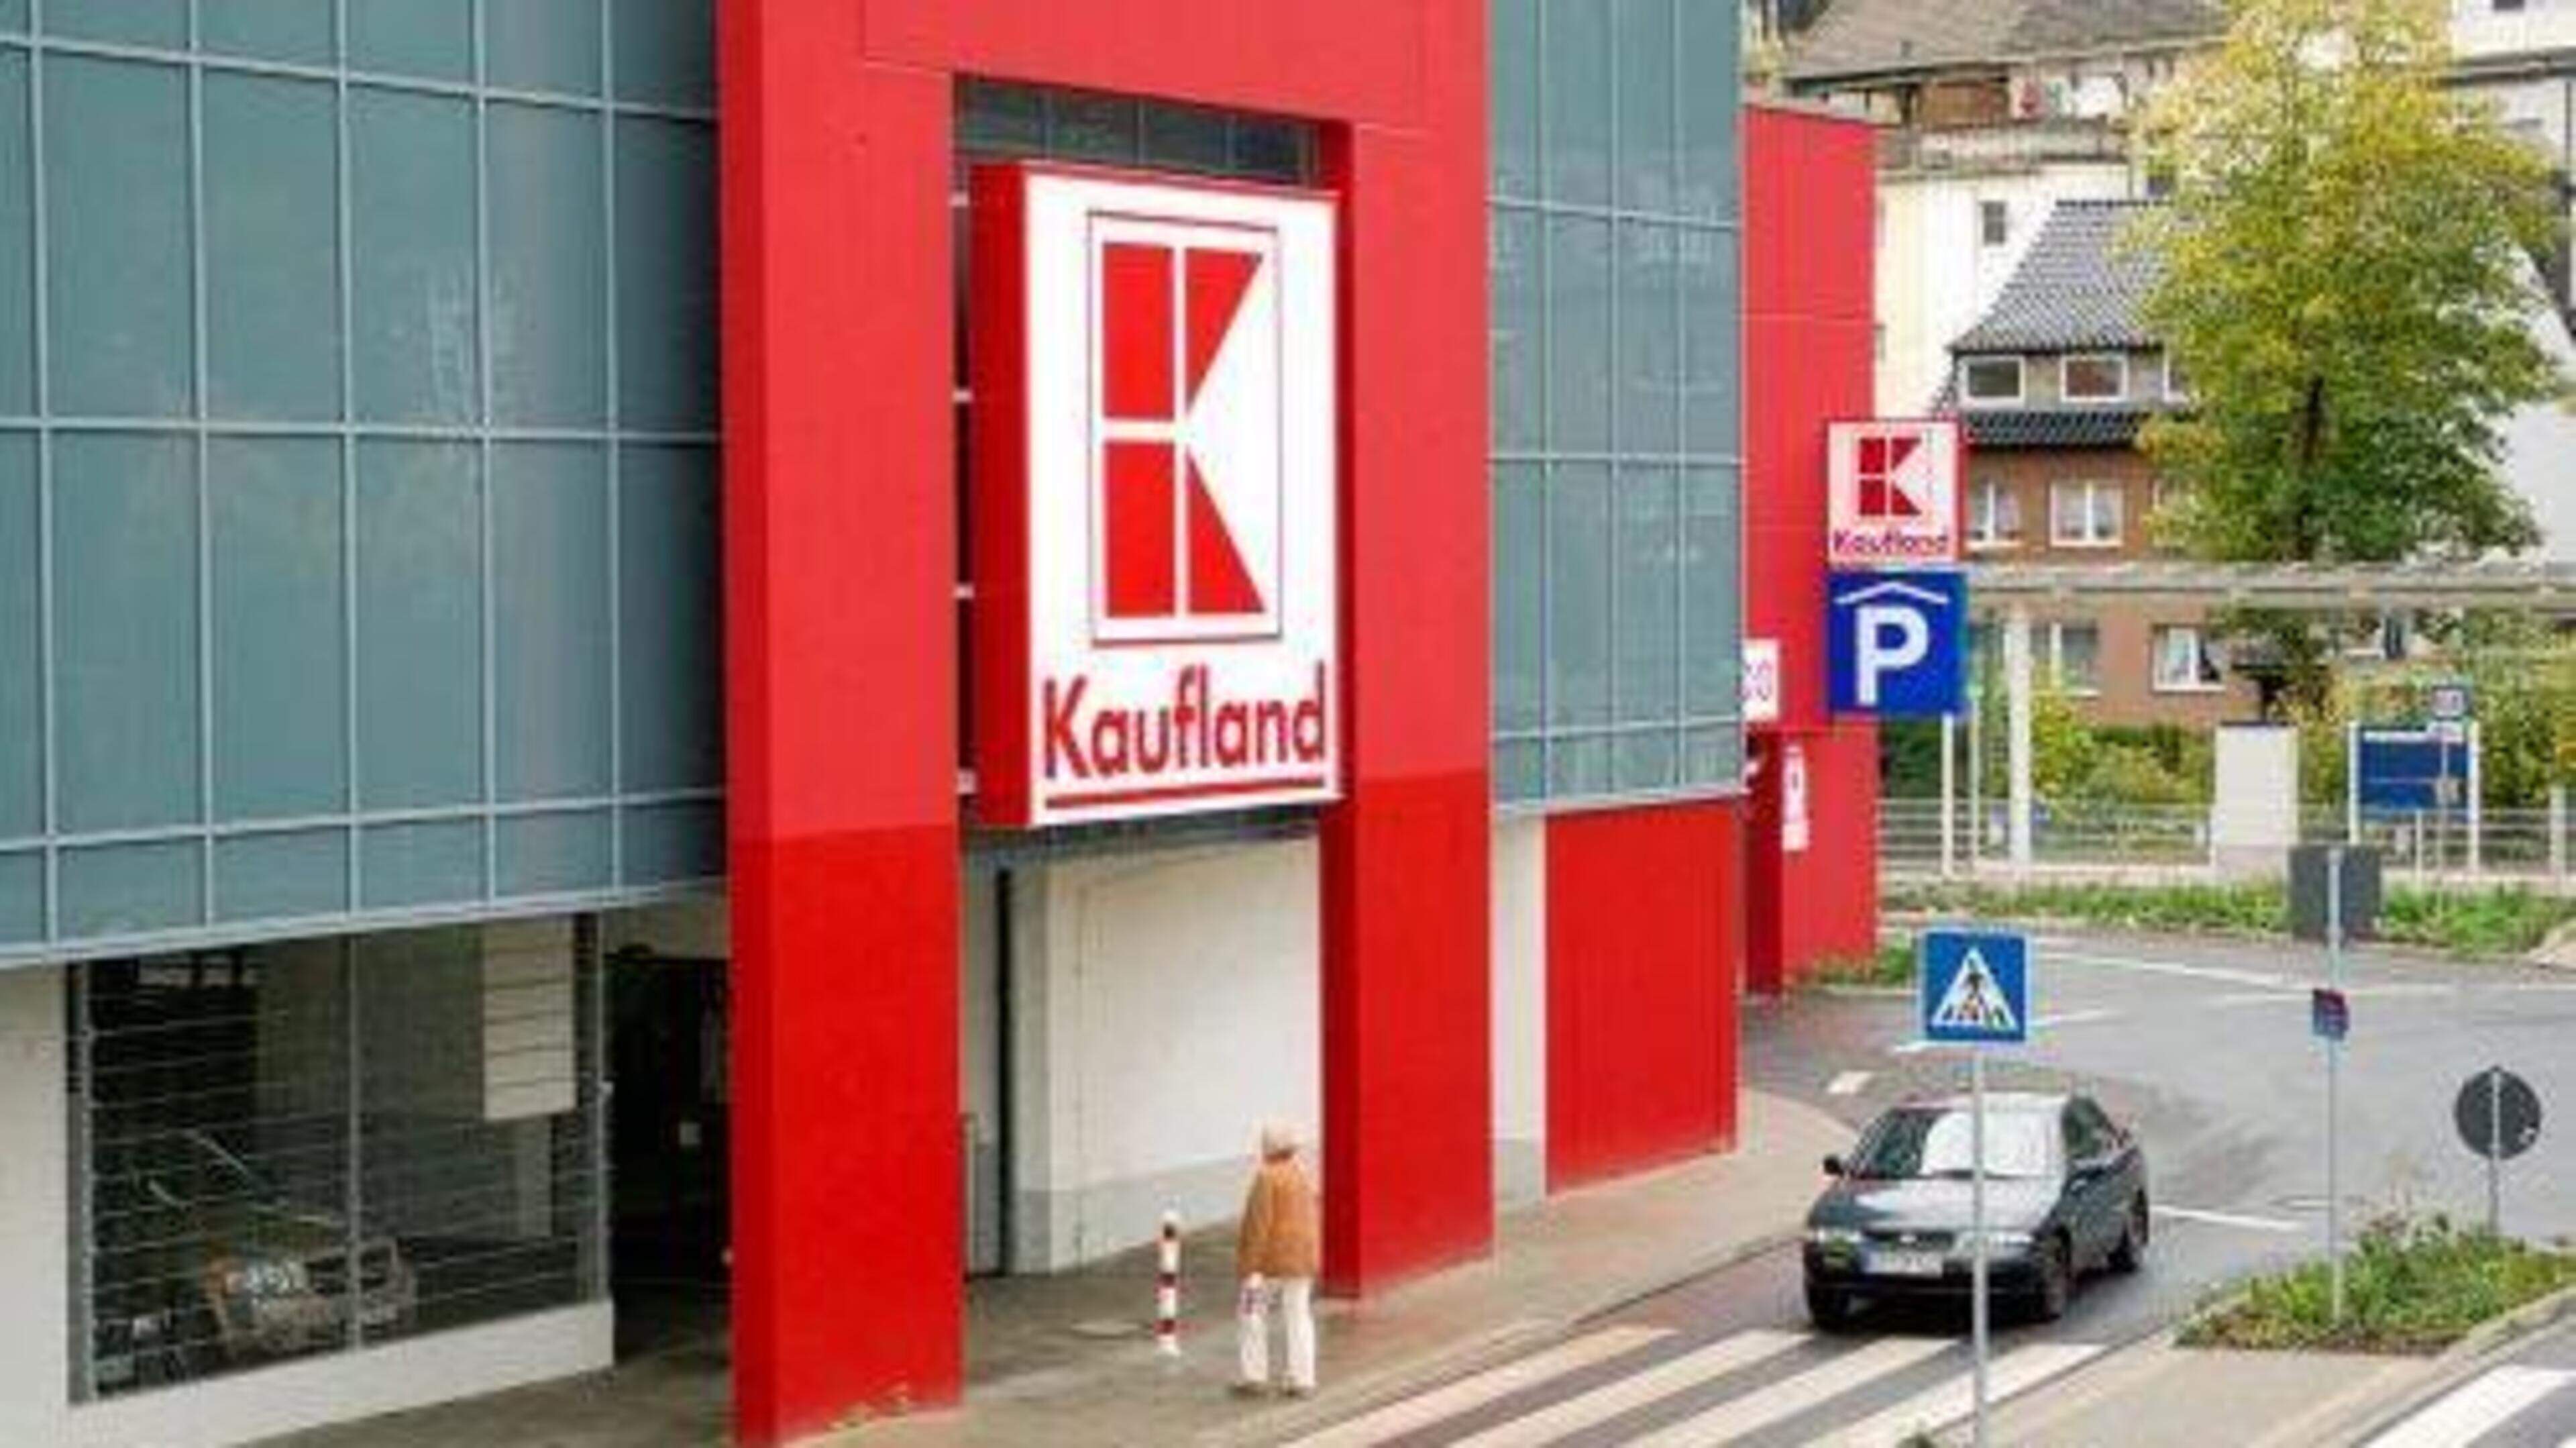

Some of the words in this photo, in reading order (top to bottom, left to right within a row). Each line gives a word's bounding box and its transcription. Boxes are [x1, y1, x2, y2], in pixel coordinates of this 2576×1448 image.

[1102, 242, 1264, 617] K
[1859, 437, 1923, 515] K
[1834, 528, 1948, 556] Kaufland
[1856, 606, 1929, 706] P
[1044, 660, 1324, 780] Kaufland
